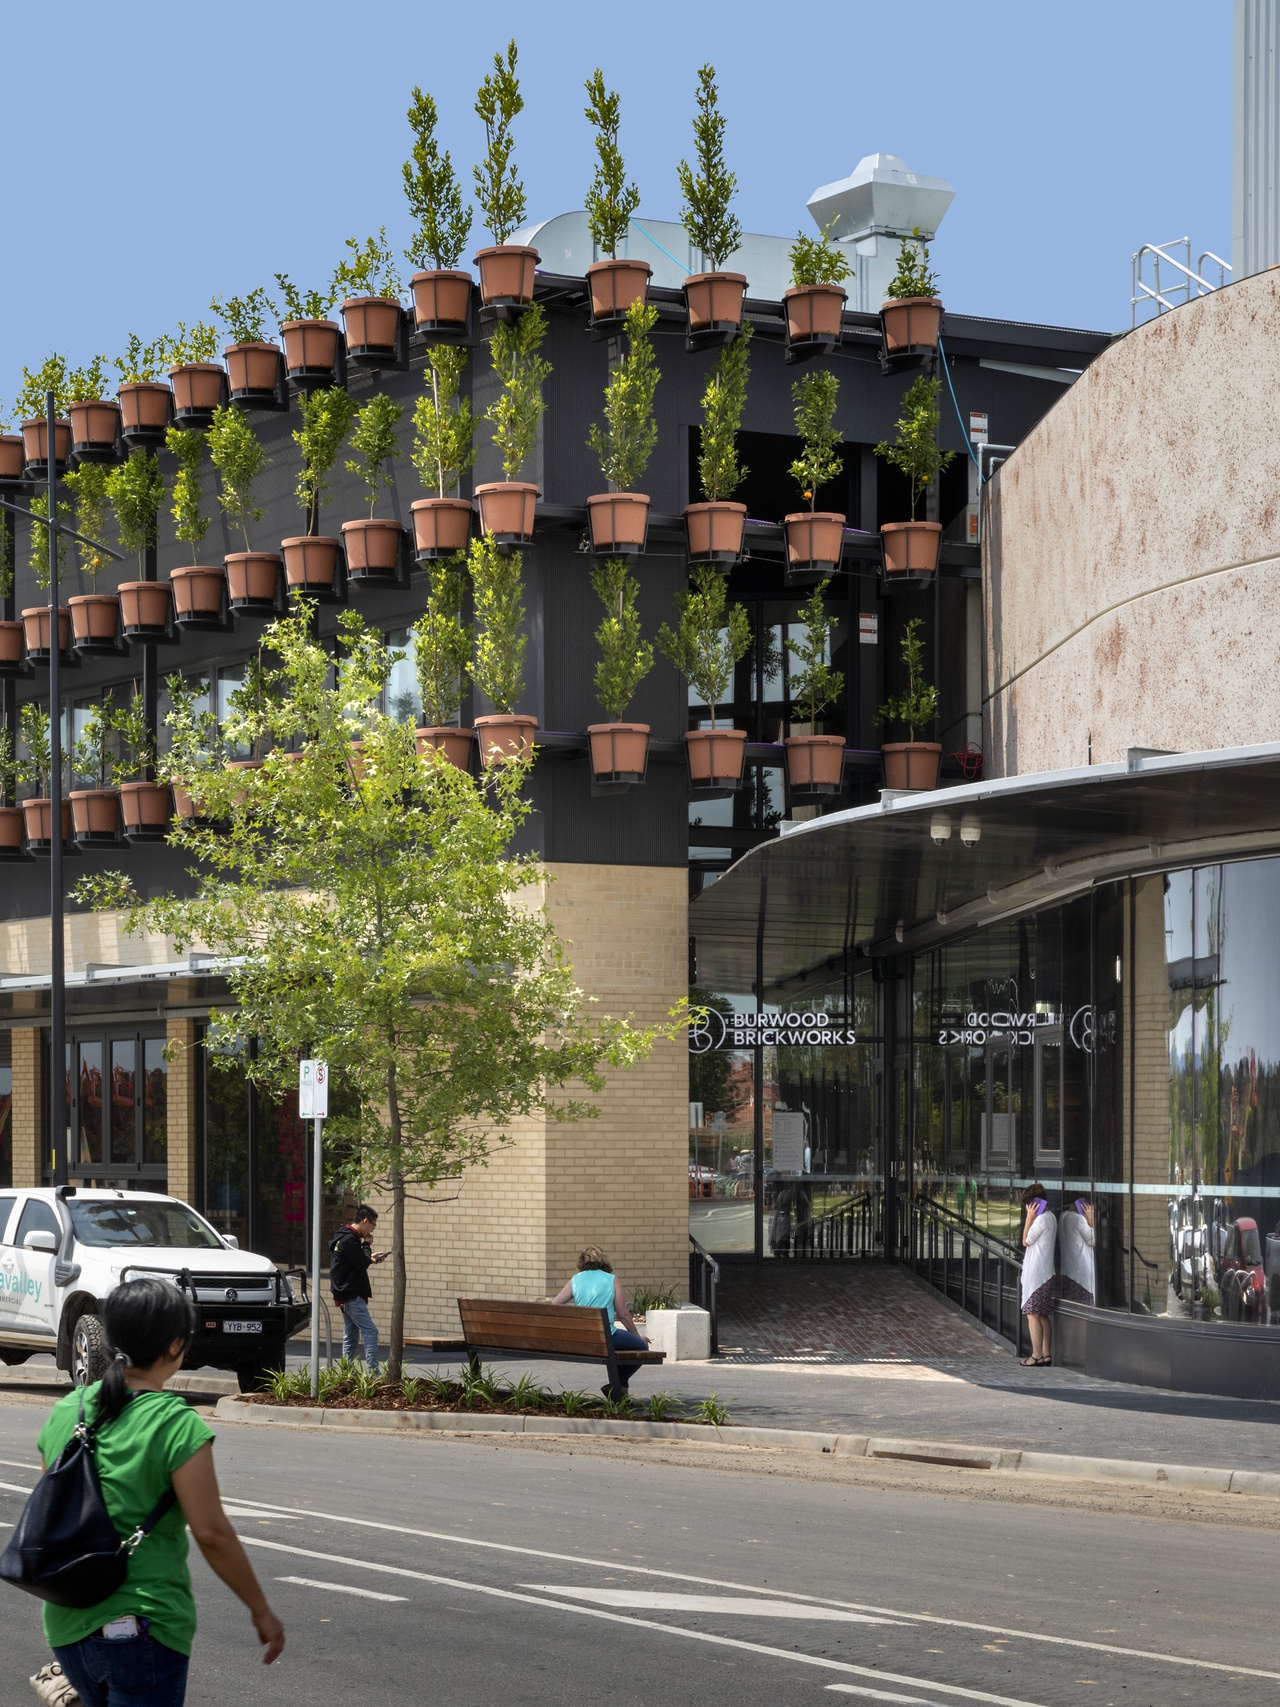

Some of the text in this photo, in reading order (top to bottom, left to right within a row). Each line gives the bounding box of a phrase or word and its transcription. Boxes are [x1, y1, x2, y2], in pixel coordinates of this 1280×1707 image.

[734, 1012, 829, 1028] BURWOOD
[734, 1030, 856, 1045] BRICKWORKS
[304, 1066, 310, 1080] P
